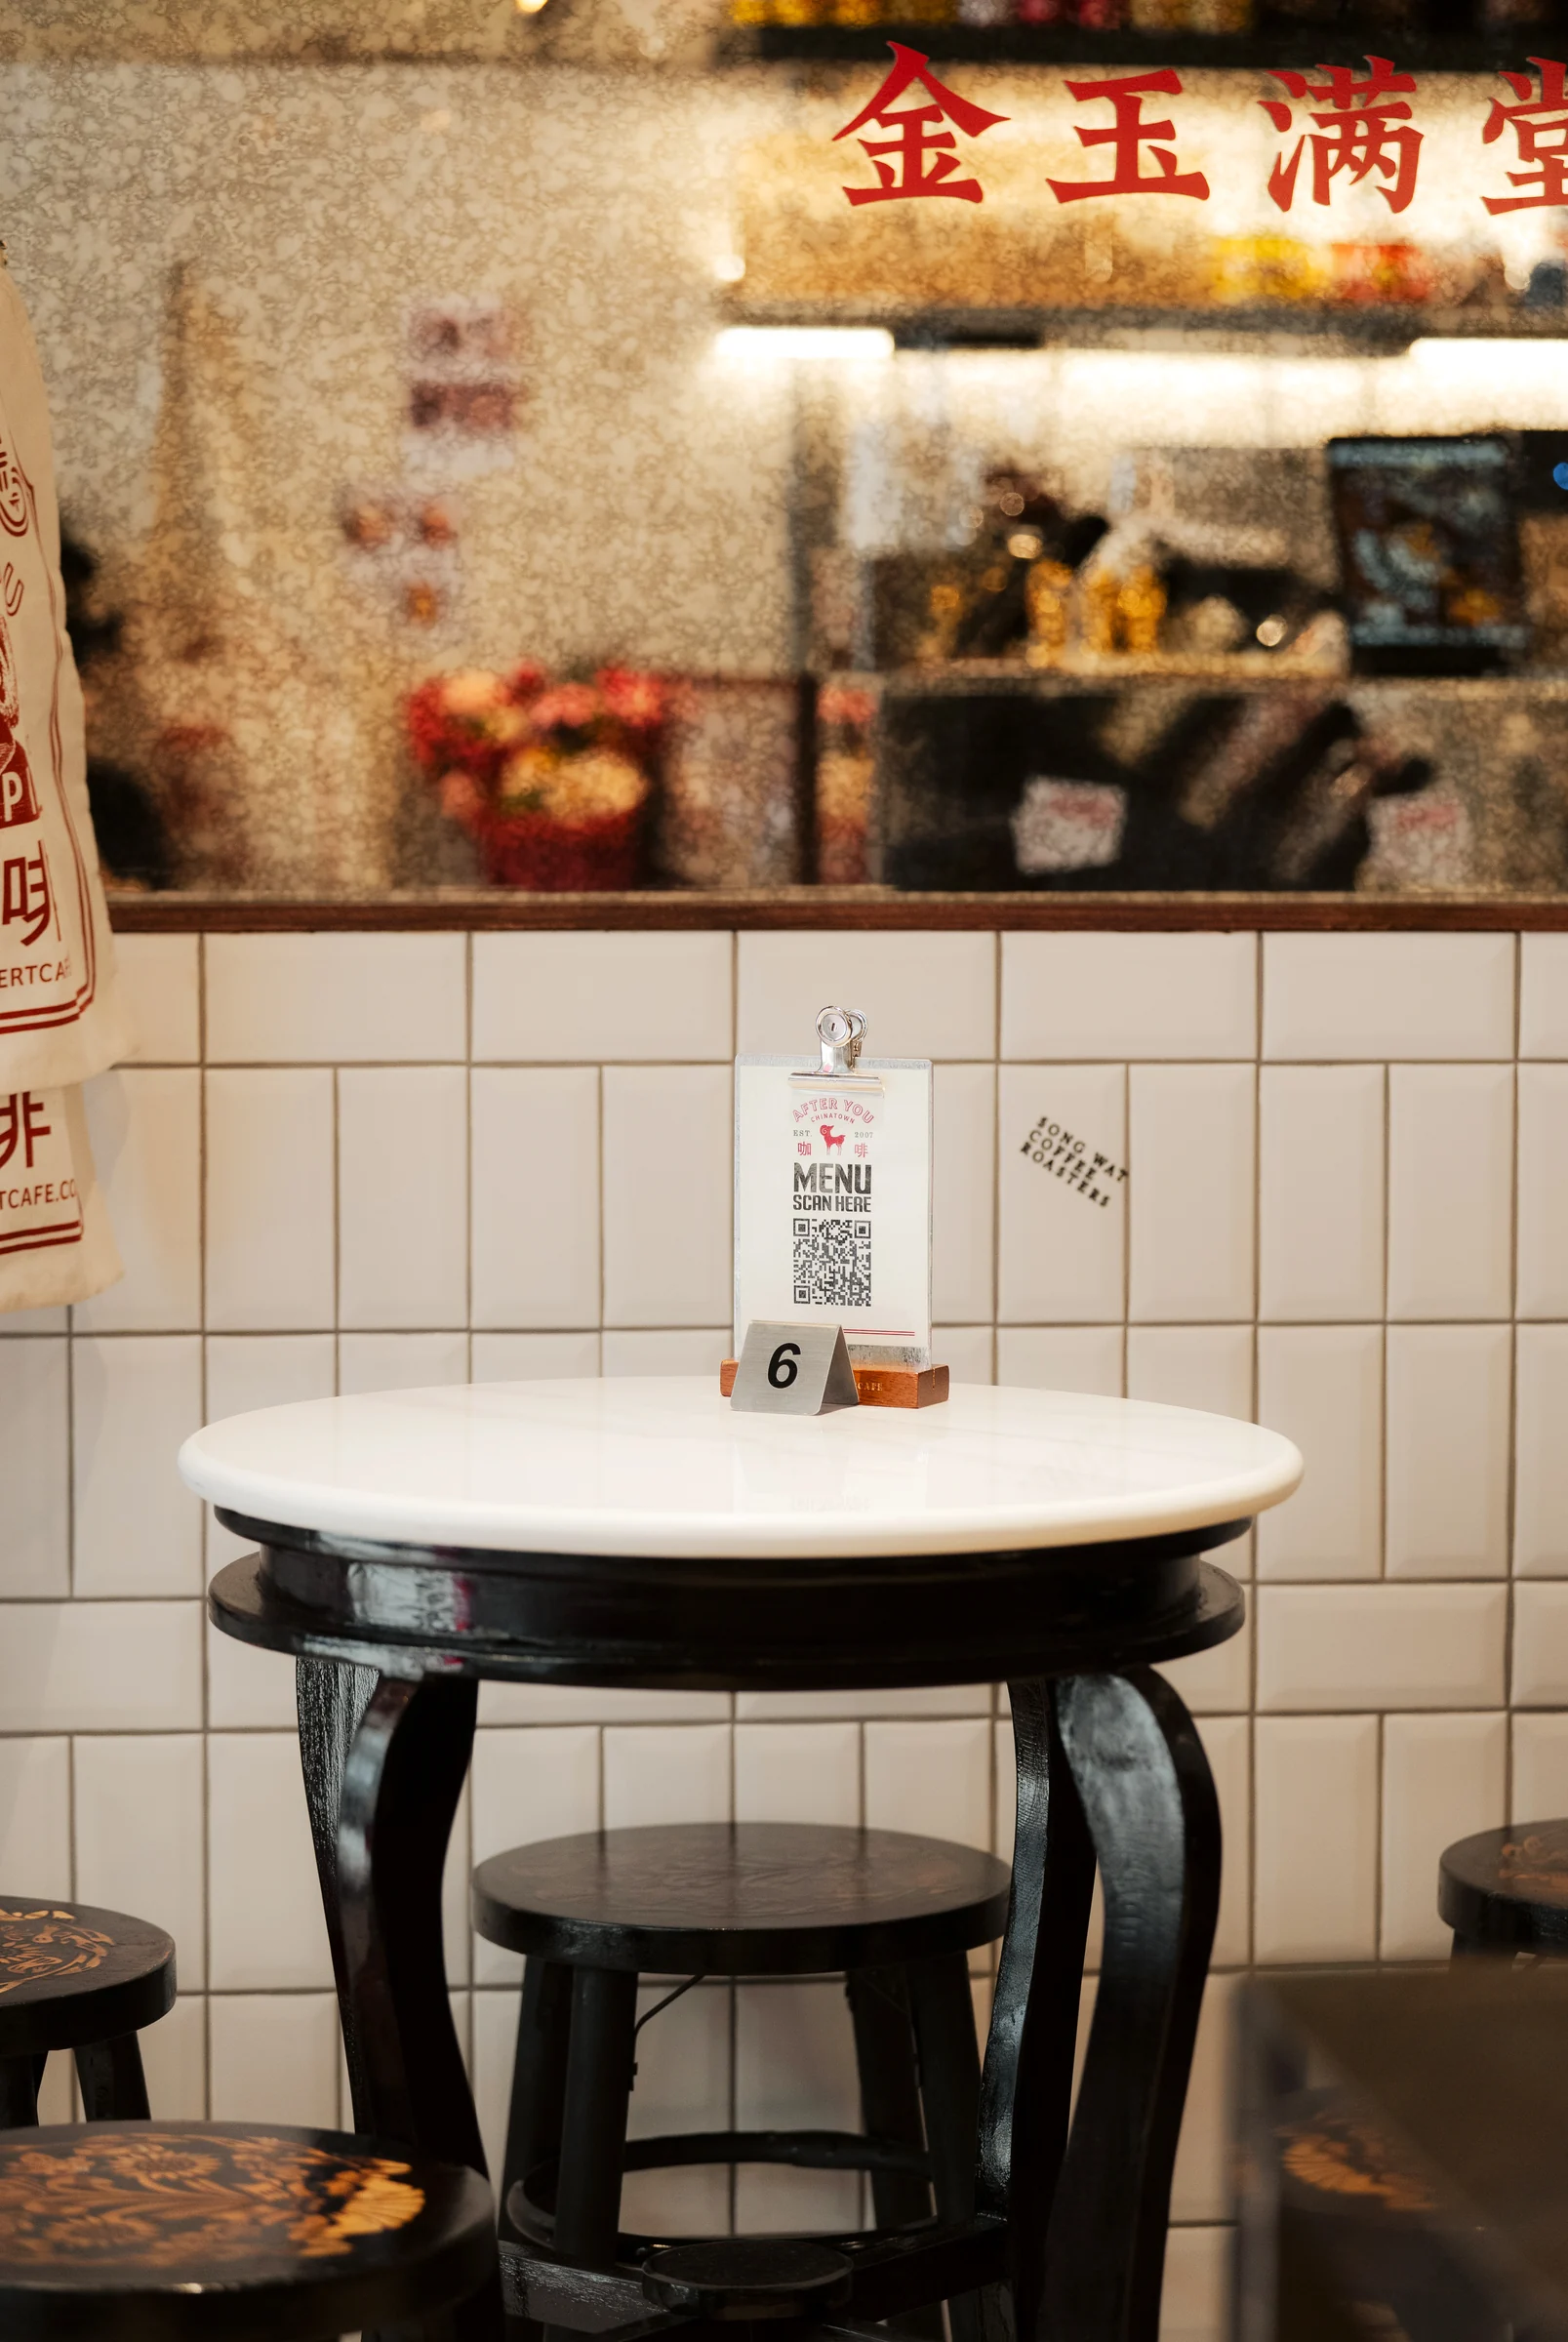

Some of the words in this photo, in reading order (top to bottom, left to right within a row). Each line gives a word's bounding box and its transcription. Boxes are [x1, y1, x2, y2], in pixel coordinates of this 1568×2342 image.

[792, 1097, 838, 1122] AFTER
[843, 1099, 874, 1124] YOU
[810, 1112, 856, 1124] CHINATOWN
[792, 1129, 813, 1138] EST.
[1037, 1116, 1086, 1154] SONG
[1093, 1151, 1129, 1182] WAT
[1029, 1129, 1097, 1181] COFFEE
[793, 1161, 872, 1194] MENU
[1020, 1141, 1110, 1207] ROASTERS
[792, 1193, 832, 1212] SCAN
[835, 1195, 872, 1213] HERE
[767, 1342, 802, 1390] 6
